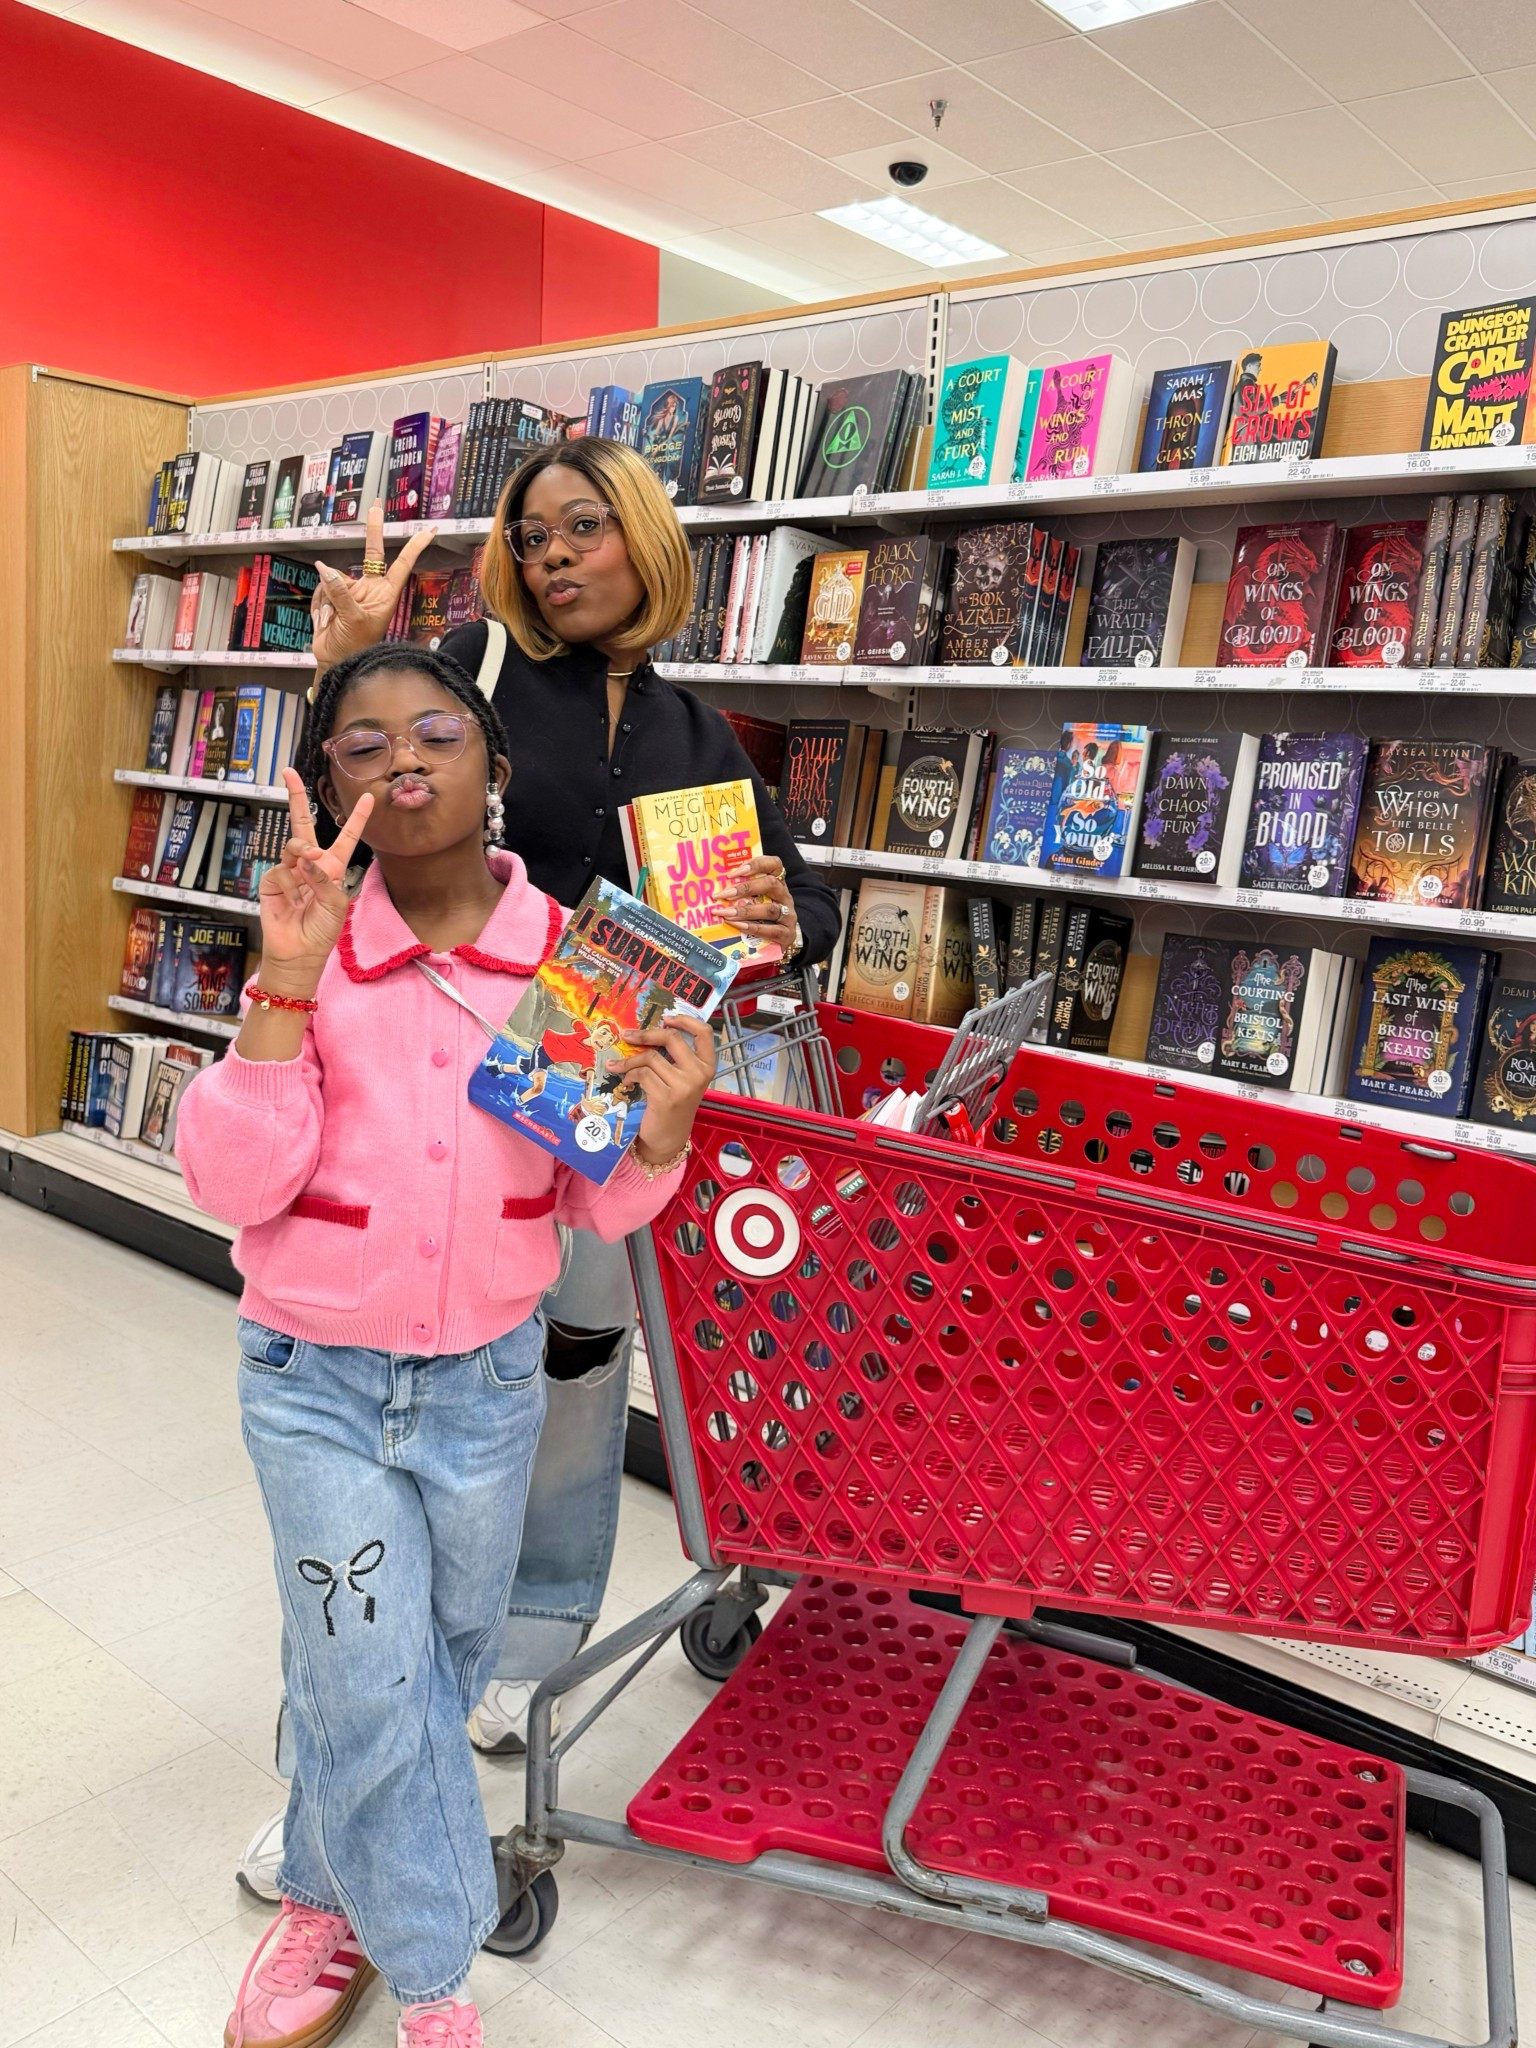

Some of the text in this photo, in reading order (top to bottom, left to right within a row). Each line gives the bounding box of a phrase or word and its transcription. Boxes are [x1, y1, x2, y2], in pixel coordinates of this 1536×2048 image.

[1447, 307, 1531, 337] DUNGEON
[1444, 324, 1529, 352] CRAWLER
[1438, 342, 1527, 395] CARL
[945, 368, 1002, 392] A COURT
[1046, 368, 1105, 393] A COURT
[1165, 372, 1215, 391] SARAH J.
[963, 391, 976, 402] OF
[1082, 389, 1097, 401] OF
[1171, 386, 1204, 403] MAAS
[1239, 380, 1312, 414] SIX OF
[713, 404, 741, 428] BLOOD
[951, 404, 985, 425] MIST
[1039, 408, 1086, 431] WINGS
[1155, 410, 1212, 431] THRONE
[1432, 396, 1518, 436] MATT
[954, 427, 975, 440] AND
[1172, 431, 1187, 442] OF
[1231, 410, 1313, 445] CROWS
[394, 434, 417, 453] FREIDA
[1049, 432, 1069, 444] AND
[389, 450, 423, 470] McFADDEN
[944, 441, 980, 461] FURY
[1054, 444, 1090, 464] RUIN
[1156, 445, 1197, 464] GLASS
[1229, 440, 1309, 463] LEIGH BARDUGO
[308, 461, 327, 478] NEVER
[340, 458, 367, 477] TEACHER
[1287, 468, 1311, 476] 22.40
[1406, 460, 1431, 468] 16.00
[395, 476, 409, 493] THE
[1189, 475, 1210, 483] 15.99
[875, 541, 922, 565] BLACK
[271, 561, 318, 590] RILEY SAG
[868, 562, 916, 587] THORN
[1266, 562, 1288, 578] ON
[1371, 562, 1393, 578] ON
[969, 591, 1005, 606] BOOK
[1244, 581, 1304, 603] WINGS
[1349, 581, 1409, 605] WINGS
[421, 597, 439, 609] ASK
[1112, 599, 1136, 611] THE
[276, 605, 304, 630] WITH
[411, 615, 446, 626] ANDREA
[956, 607, 1015, 626] AZRAEL
[1096, 612, 1153, 629] WRATH
[1260, 606, 1279, 621] OF
[1363, 607, 1382, 622] OF
[946, 639, 989, 650] AMBER
[1225, 624, 1302, 647] BLOOD
[1332, 626, 1406, 650] BLOOD
[1088, 635, 1159, 659] FALLEN
[1300, 676, 1324, 685] 21.00
[1418, 678, 1434, 686] 22.40
[1450, 678, 1466, 687] 22.40
[789, 736, 843, 761] CALLIE
[1434, 748, 1471, 758] LYNN
[1081, 760, 1107, 779] So
[1258, 761, 1342, 791] PROMISED
[902, 777, 954, 796] FOURTH
[1070, 779, 1110, 800] Old.
[1165, 776, 1209, 790] DAWN
[1289, 792, 1302, 809] IN
[1375, 786, 1459, 820] WHOM
[1417, 790, 1440, 799] FOR
[654, 790, 745, 820] MEGHAN
[900, 794, 951, 818] WING
[1159, 799, 1208, 813] CHAOS
[173, 814, 192, 830] QUITE
[668, 810, 739, 838] QUINN
[1071, 812, 1097, 833] So
[1163, 820, 1201, 835] FURY
[1255, 811, 1328, 848] BLOOD
[1391, 820, 1454, 831] THE BELLE
[169, 829, 187, 844] DEAD
[1372, 830, 1455, 856] TOLLS
[1075, 856, 1105, 868] Ginder
[1138, 885, 1158, 894] 15.96
[1252, 879, 1314, 892] SADIE KINCAID
[1236, 895, 1258, 904] 23.09
[1491, 904, 1518, 913] LAUREN
[1342, 905, 1366, 914] 23.80
[981, 903, 990, 940] REBECCA
[1459, 917, 1485, 927] 20.99
[189, 928, 243, 947] JOE HILL
[621, 919, 687, 964] THE GRAPHIC NOVEL
[640, 919, 659, 936] CASSIE
[659, 932, 691, 955] ANDERSON
[857, 926, 911, 949] FOURTH
[1075, 913, 1088, 951] REBECCA
[667, 930, 695, 949] LAUREN
[695, 945, 723, 967] TARSHIS
[855, 943, 908, 972] WING
[577, 948, 607, 971] WILDFIRES,
[580, 943, 624, 974] THE CALIFORNIA
[590, 917, 714, 1008] SURVIVED
[1086, 962, 1121, 983] FOURTH
[1254, 972, 1271, 987] The
[197, 972, 226, 993] KING
[1405, 977, 1428, 993] The
[1502, 986, 1527, 997] DEMI
[1084, 980, 1117, 1005] WING
[1231, 985, 1295, 1003] COURTING
[1054, 999, 1063, 1023] WING
[1253, 1000, 1264, 1014] of
[1372, 991, 1459, 1014] LAST WISH
[1060, 996, 1073, 1030] FOURTH
[1234, 1012, 1283, 1029] BRISTOL
[1404, 1010, 1419, 1026] of
[1237, 1027, 1274, 1042] KEATS
[1377, 1023, 1444, 1044] BRISTOL
[1382, 1040, 1432, 1060] KEATS
[159, 1064, 183, 1084] STEPHEN
[1236, 1089, 1258, 1099] 15.99
[1360, 1078, 1386, 1089] MARY
[1388, 1083, 1397, 1091] E.
[1398, 1085, 1444, 1100] PEARSON
[1334, 1108, 1358, 1118] 23.09
[520, 1116, 560, 1145] SCHOLASTIC
[1487, 1655, 1514, 1672] 15.99
